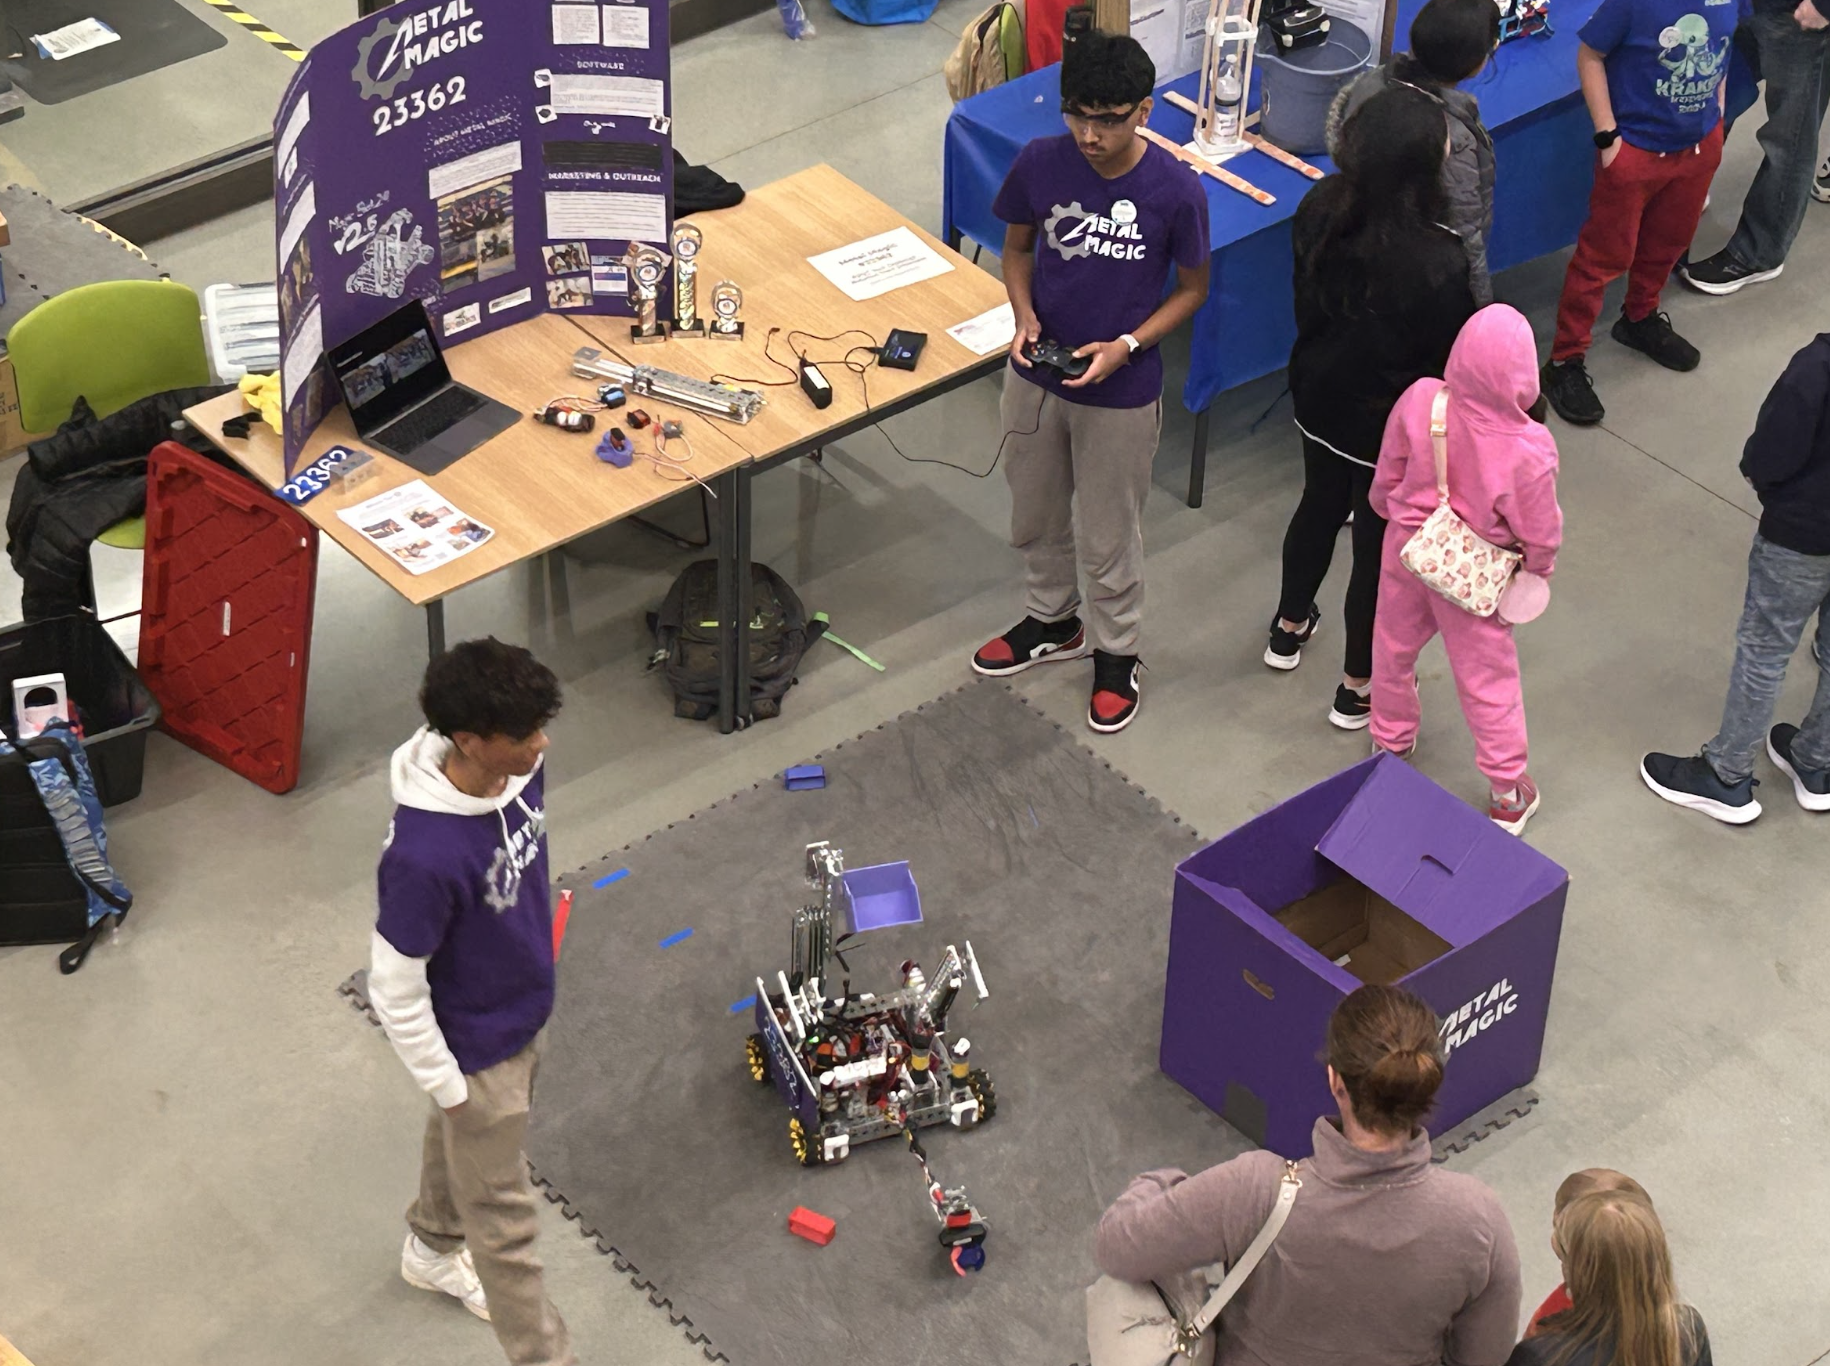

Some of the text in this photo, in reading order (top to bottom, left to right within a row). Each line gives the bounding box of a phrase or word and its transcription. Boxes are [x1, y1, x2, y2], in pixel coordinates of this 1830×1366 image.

[404, 20, 484, 70] MAGIC
[373, 75, 466, 136] 23362
[1060, 212, 1143, 240] METAL
[1084, 234, 1147, 260] MAGIC
[1438, 978, 1513, 1037] METAL
[1444, 993, 1519, 1054] MAGIC
